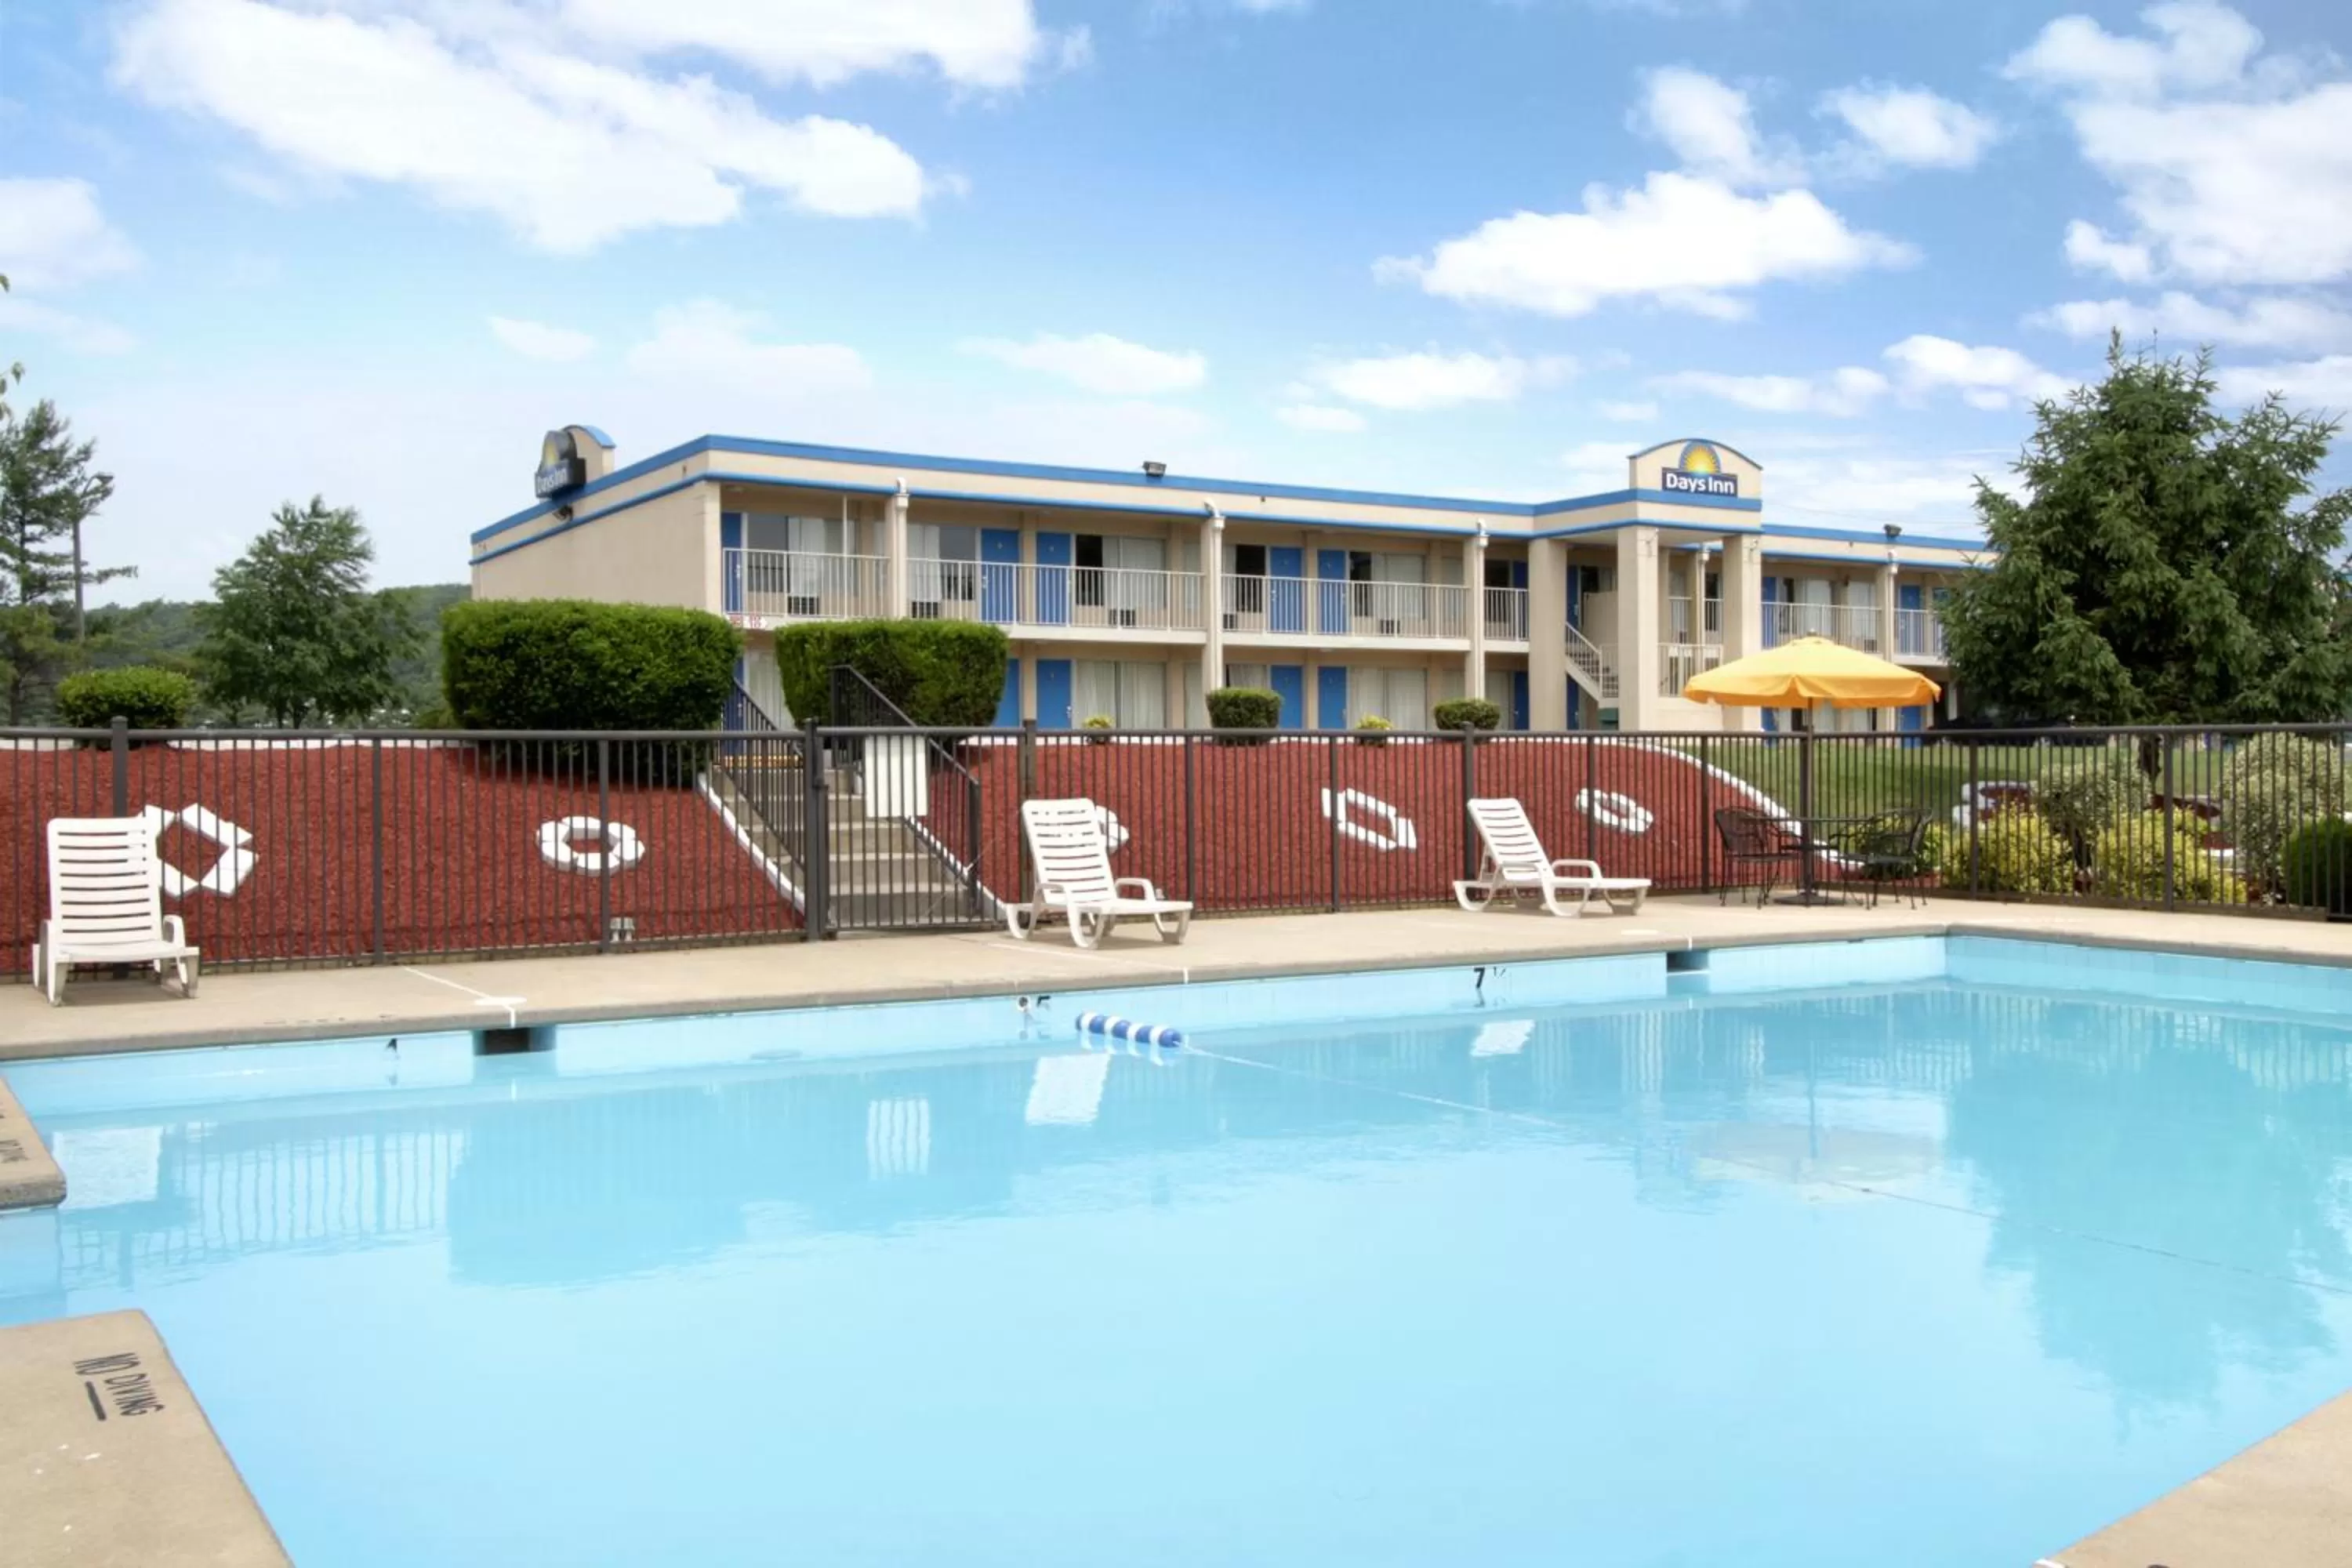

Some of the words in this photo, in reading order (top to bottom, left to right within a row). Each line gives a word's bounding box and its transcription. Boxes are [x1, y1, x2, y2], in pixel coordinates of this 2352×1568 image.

[1666, 473, 1705, 492] Days
[1708, 477, 1734, 493] Inn
[73, 1352, 140, 1375] NO
[104, 1373, 165, 1416] DIVING
